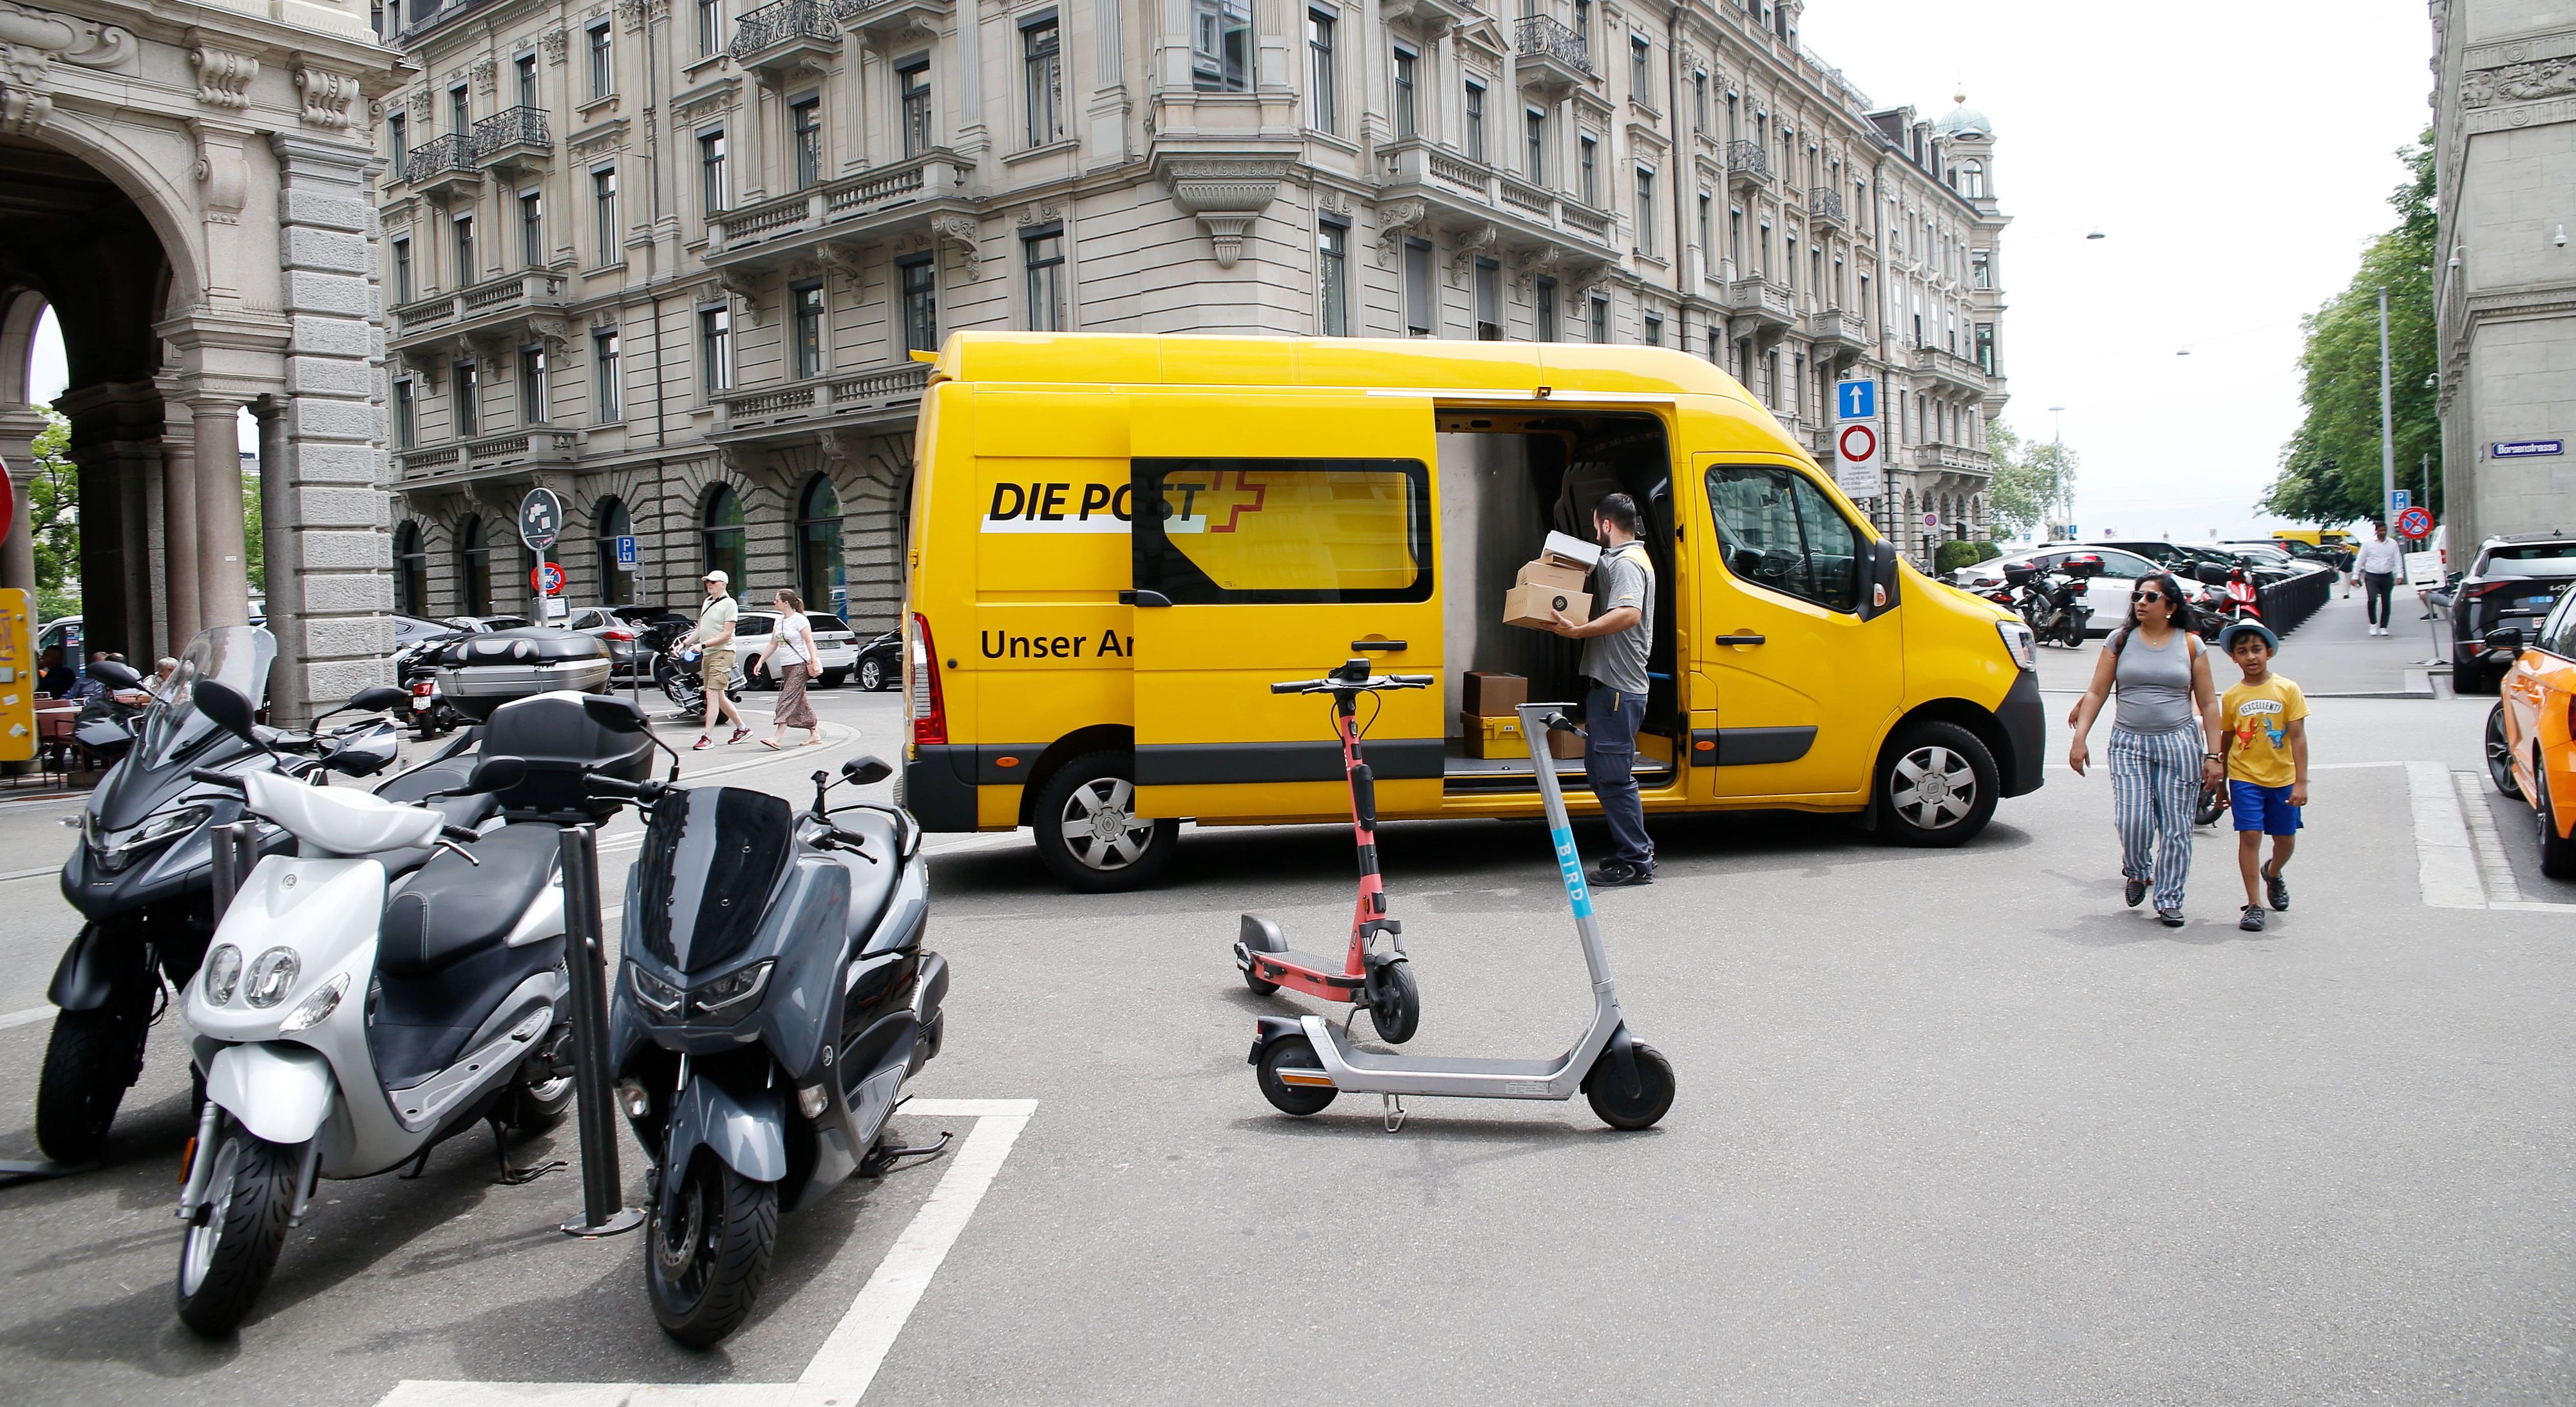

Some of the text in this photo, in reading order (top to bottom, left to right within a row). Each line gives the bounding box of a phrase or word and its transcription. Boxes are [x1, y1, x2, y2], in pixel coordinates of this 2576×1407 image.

[2497, 443, 2557, 454] Börsenstrasse
[989, 483, 1070, 521] DIE
[2396, 493, 2403, 502] P
[623, 539, 630, 551] P
[981, 630, 1086, 659] Unser
[2241, 702, 2281, 713] REXCELLENT!
[1558, 842, 1583, 901] BIRD
